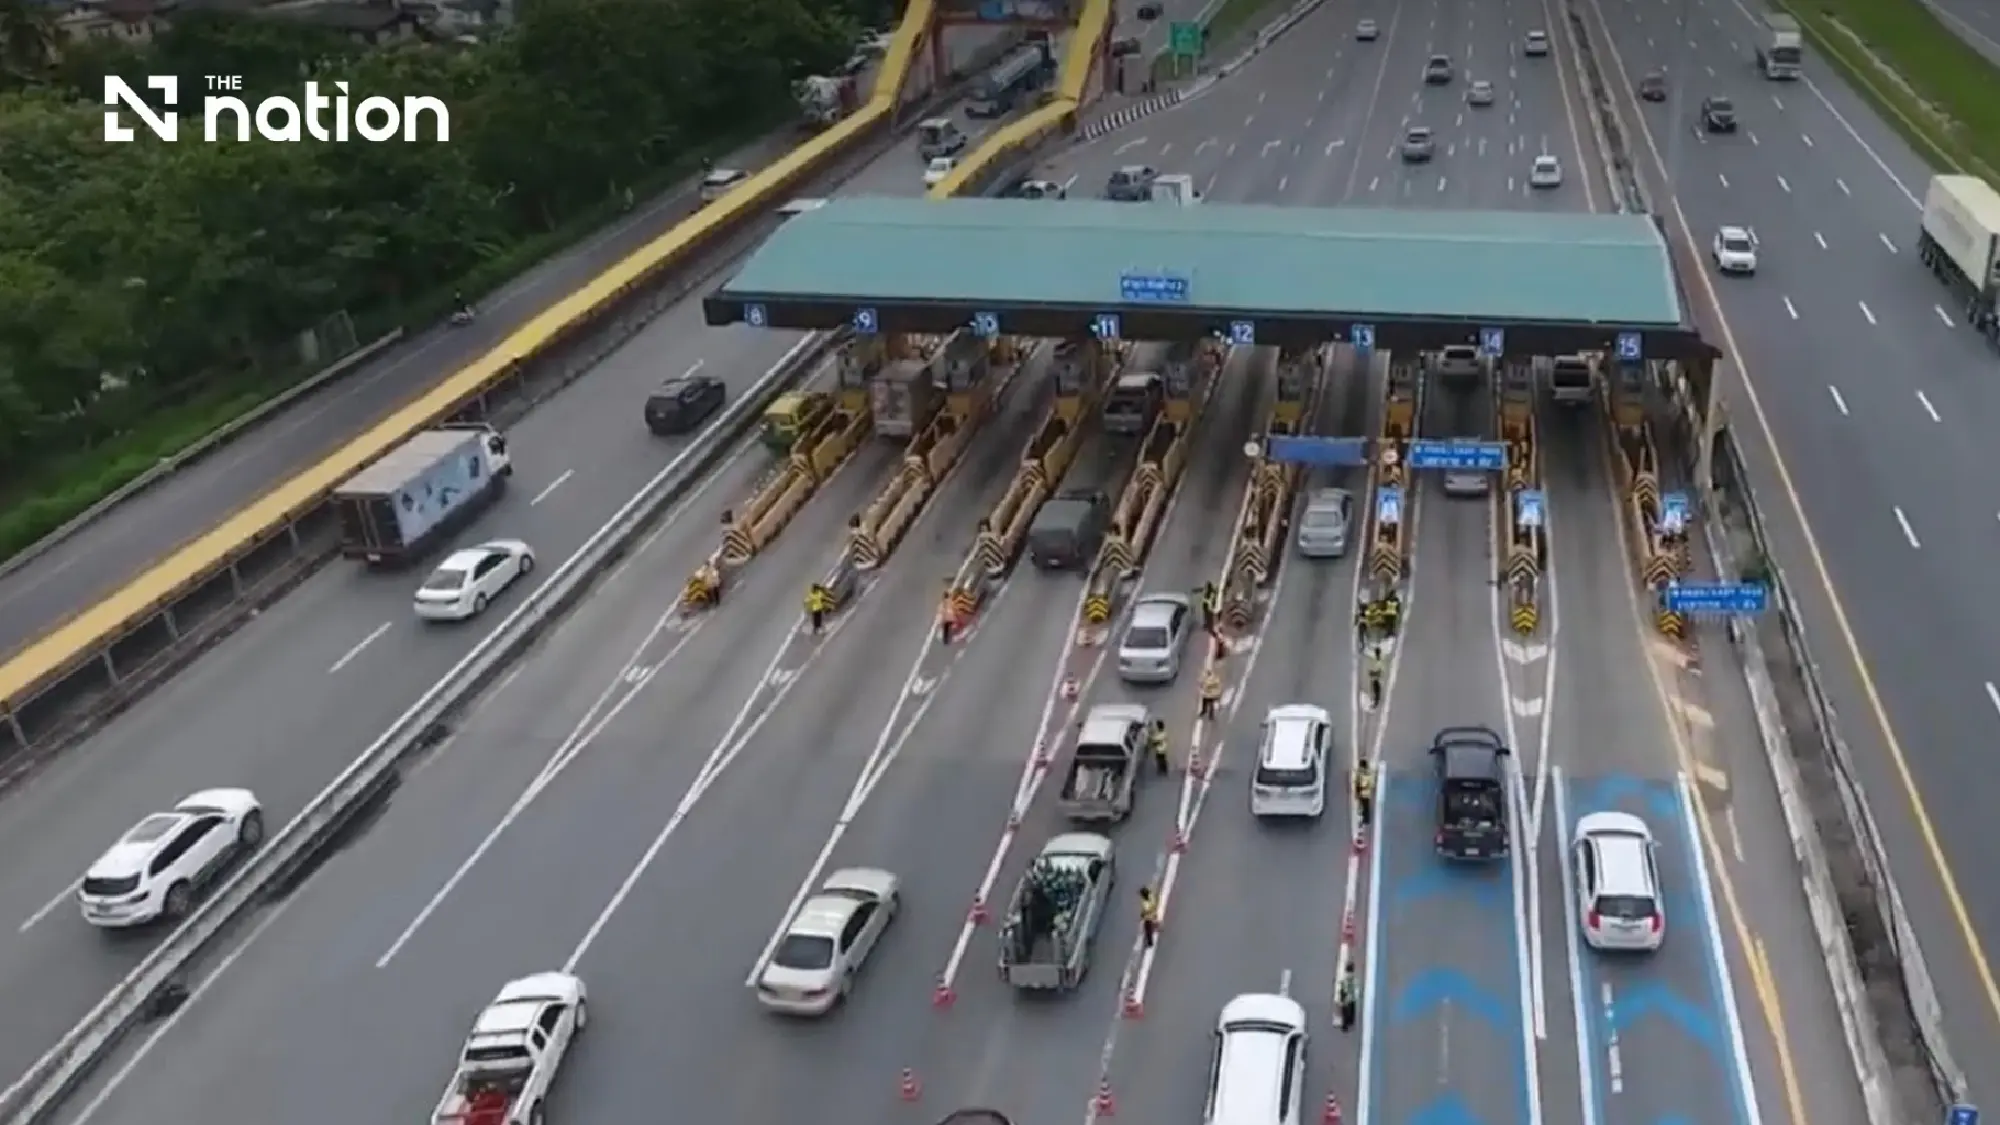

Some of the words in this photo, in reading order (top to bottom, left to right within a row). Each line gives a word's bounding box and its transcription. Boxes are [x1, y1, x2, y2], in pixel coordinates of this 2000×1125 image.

[750, 308, 763, 325] 8
[1100, 319, 1116, 338] 11
[1231, 323, 1253, 342] 12
[1354, 328, 1373, 347] 13
[1485, 333, 1501, 351] 14
[1618, 337, 1639, 356] 15
